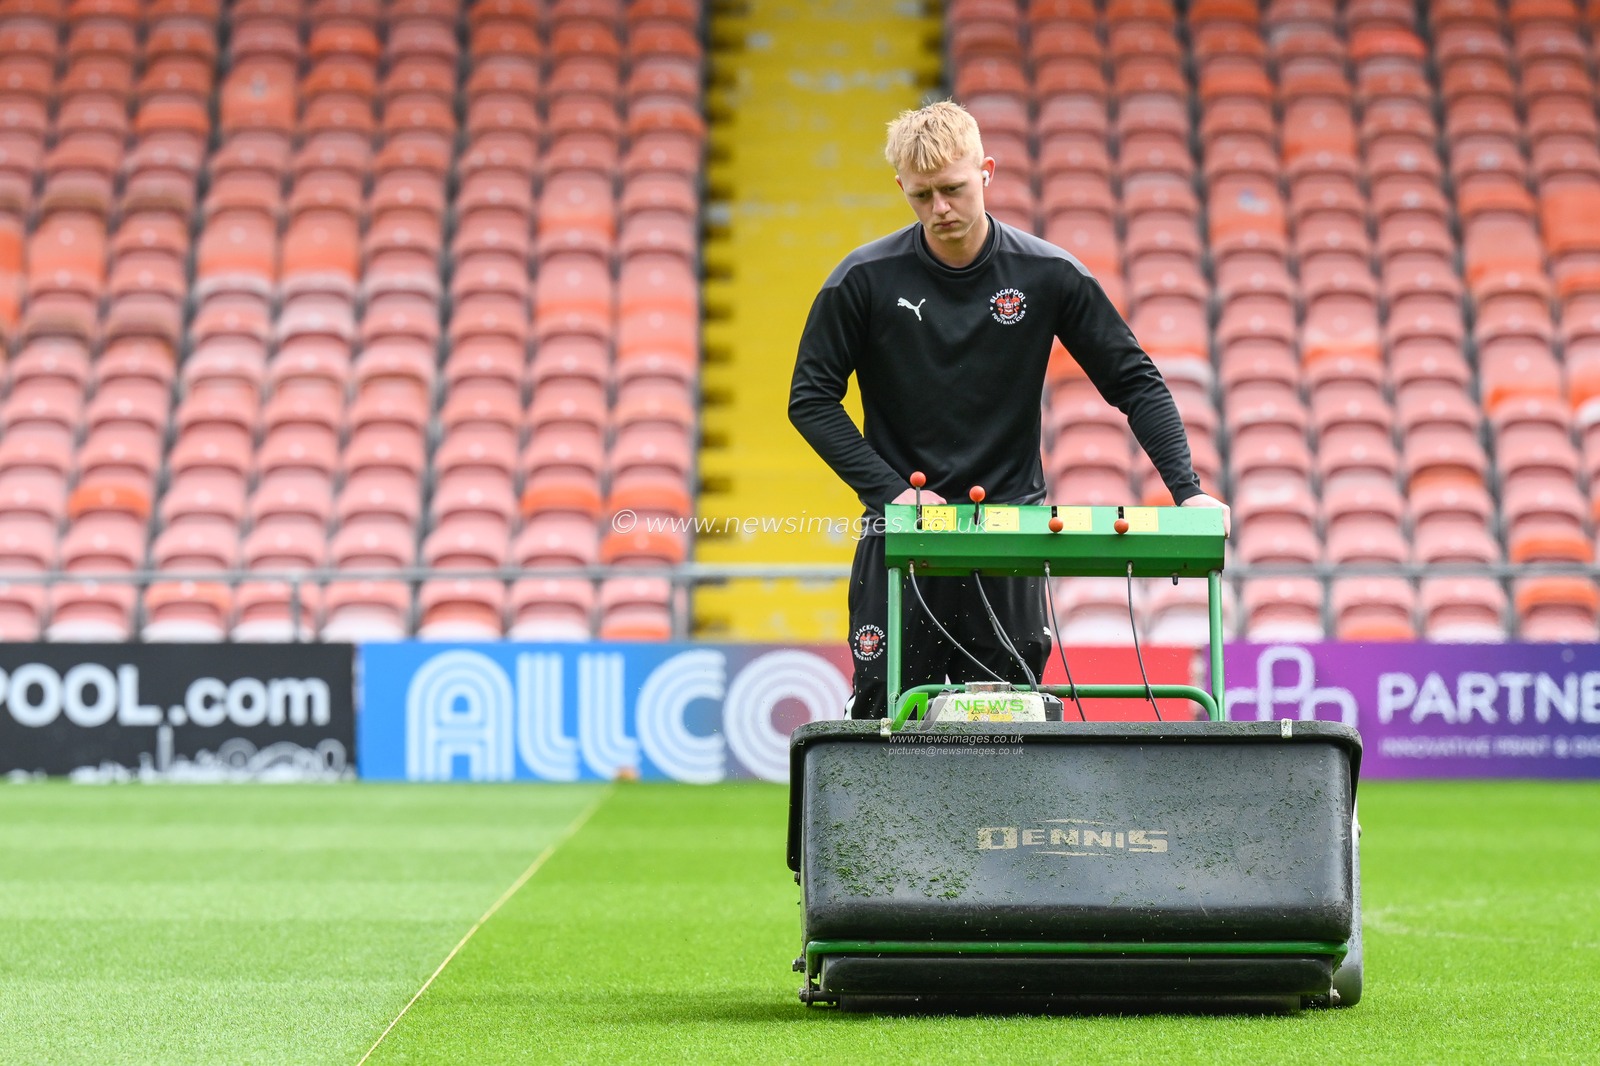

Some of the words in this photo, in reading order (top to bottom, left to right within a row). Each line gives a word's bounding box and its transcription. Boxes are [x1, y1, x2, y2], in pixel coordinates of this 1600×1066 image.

[990, 288, 1026, 304] BLACKPOOL
[0, 662, 331, 727] OOL.com
[977, 827, 1168, 852] DENNIS
